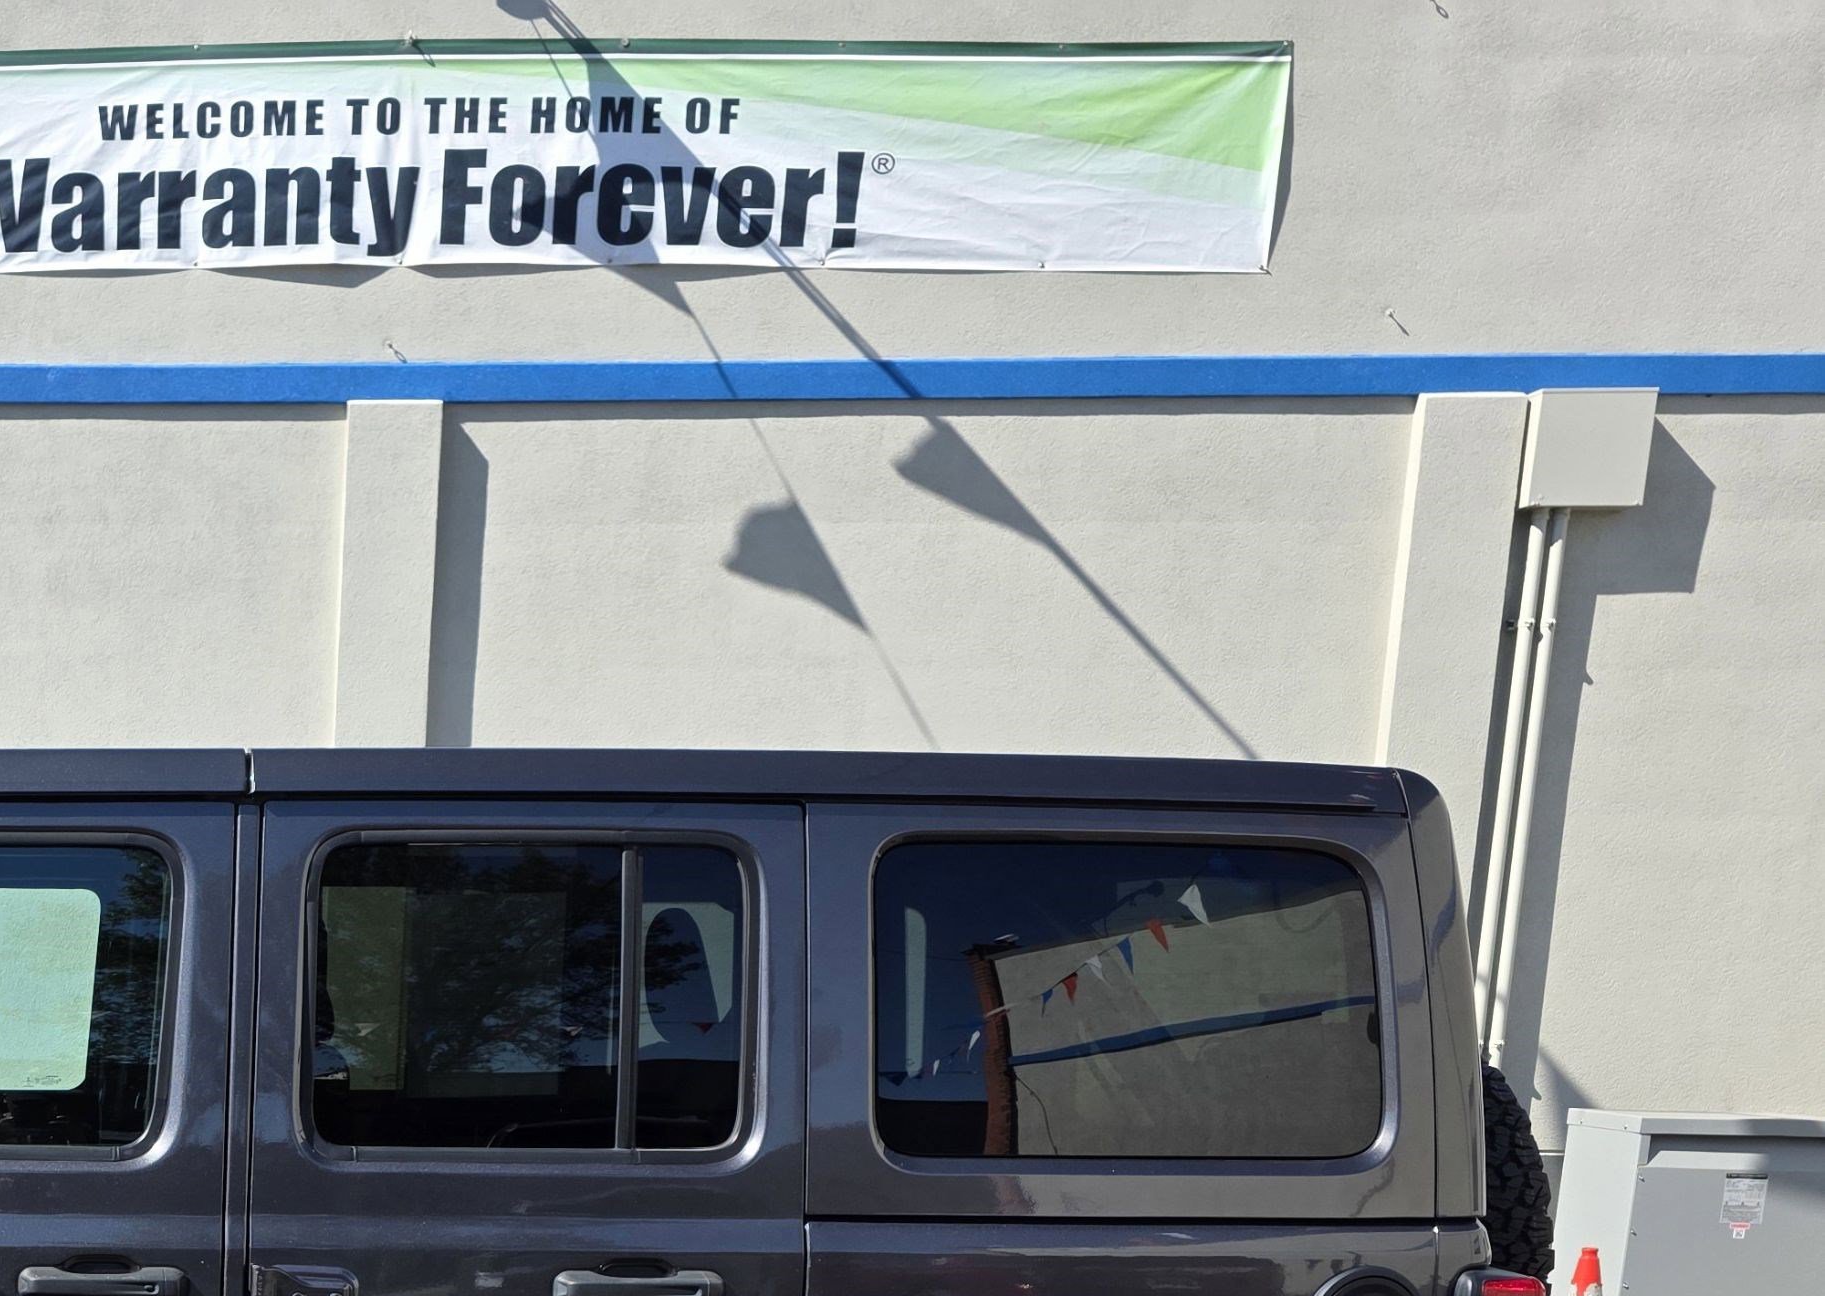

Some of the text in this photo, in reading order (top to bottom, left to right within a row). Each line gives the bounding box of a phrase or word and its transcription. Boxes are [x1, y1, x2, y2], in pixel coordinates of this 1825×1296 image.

[99, 96, 740, 141] WELCOME TO THE HOME OF
